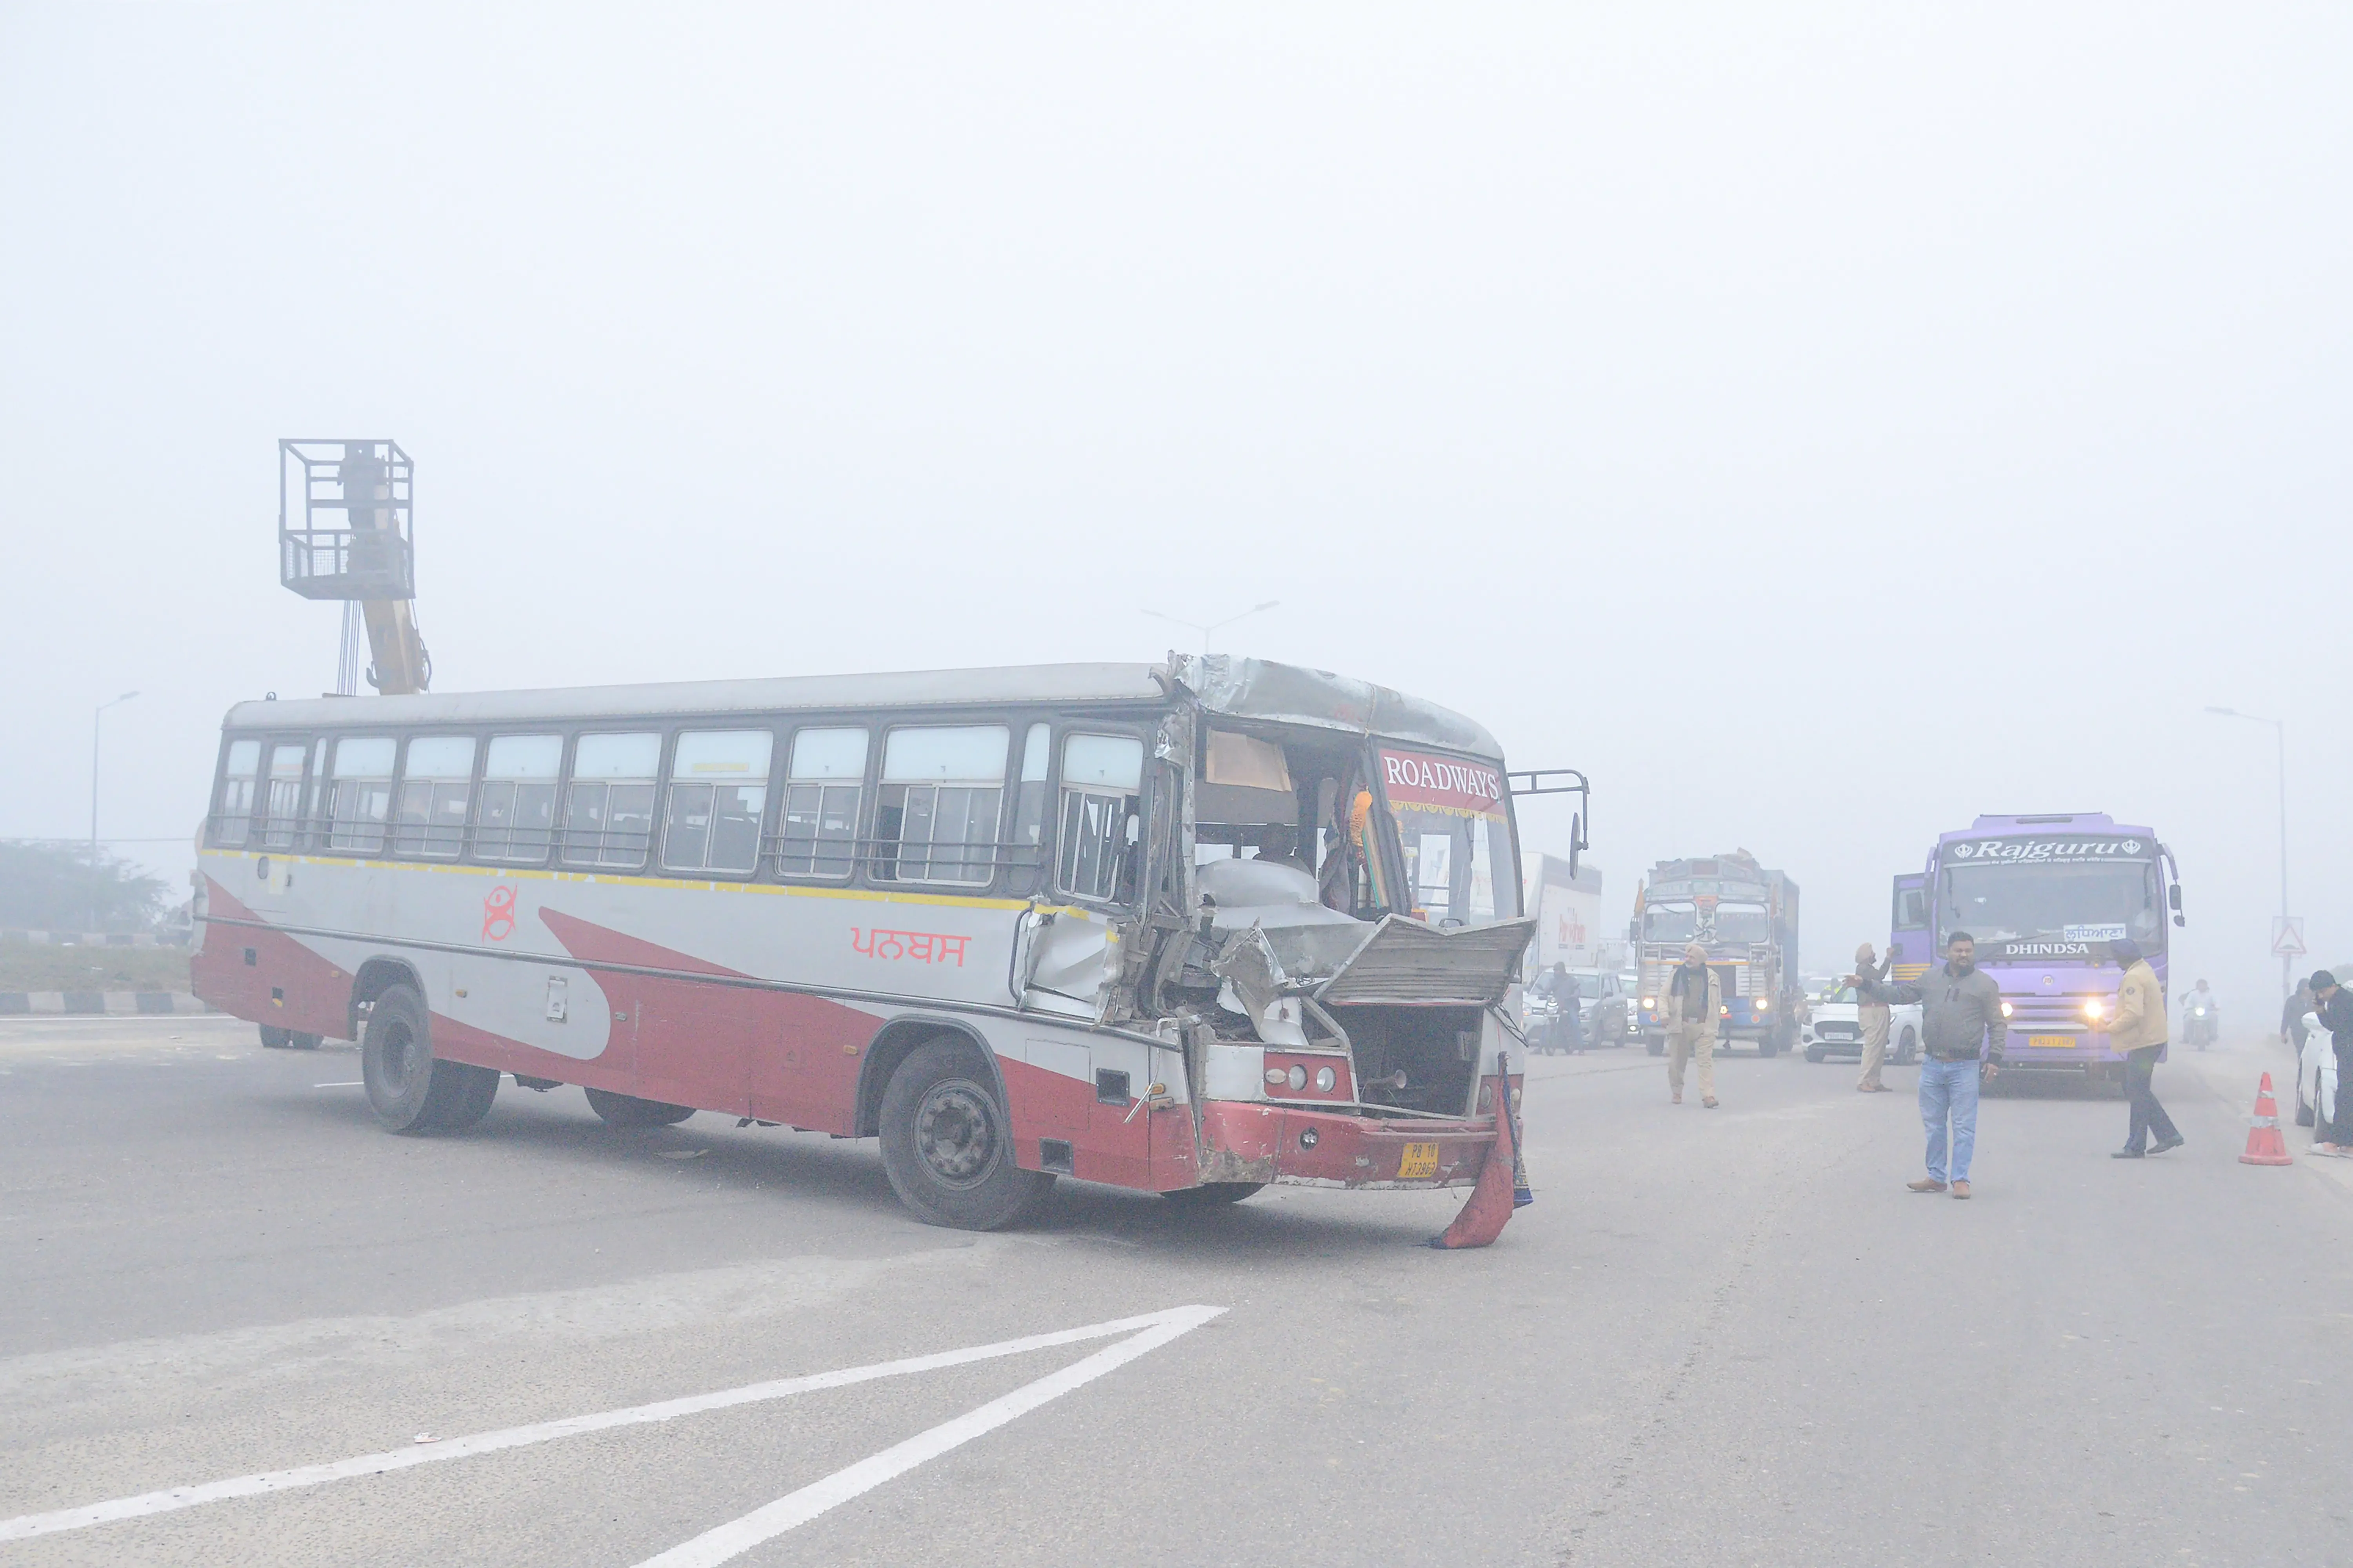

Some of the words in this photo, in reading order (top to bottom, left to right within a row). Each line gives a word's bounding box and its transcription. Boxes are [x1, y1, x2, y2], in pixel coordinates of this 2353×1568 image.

[1384, 756, 1499, 800] ROADWAYS
[1973, 841, 2118, 859] Rajguru
[850, 927, 972, 967] ਪਨਬਸ
[2006, 943, 2089, 954] DHINDSA
